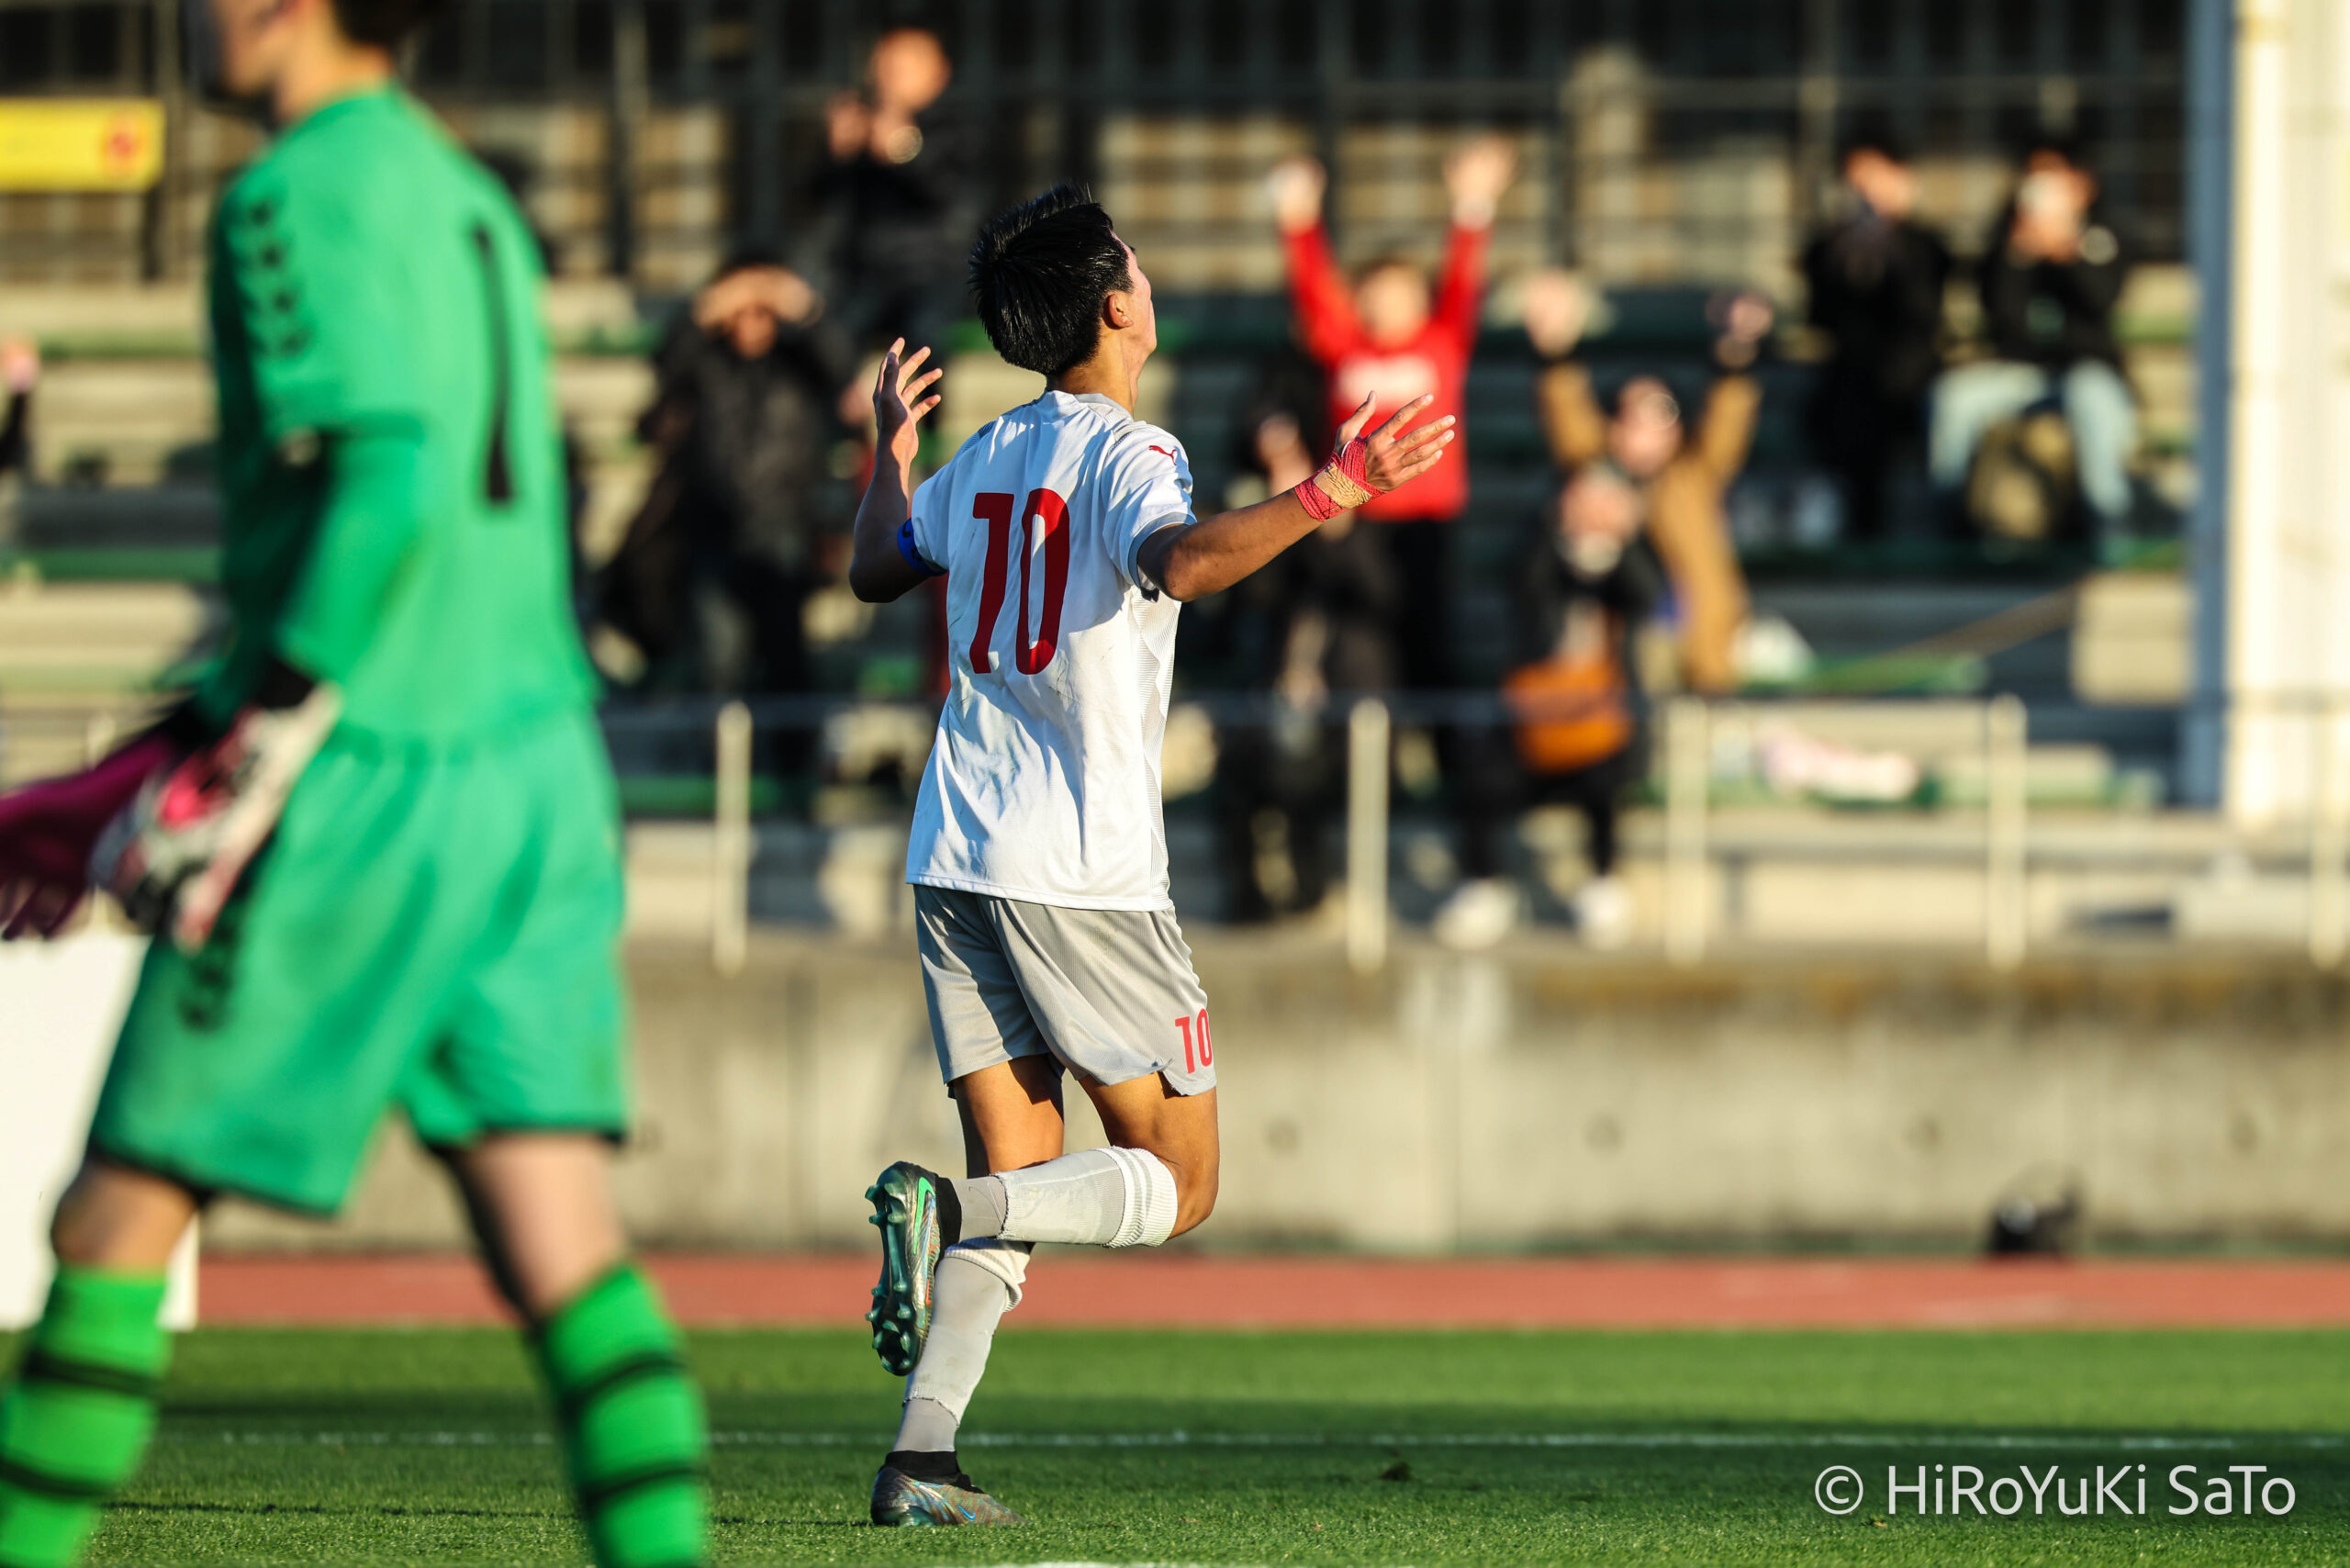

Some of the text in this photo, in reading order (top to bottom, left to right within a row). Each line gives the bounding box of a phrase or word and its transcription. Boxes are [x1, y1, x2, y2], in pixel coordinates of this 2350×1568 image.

[471, 220, 514, 503] 1
[969, 487, 1070, 676] 10
[1174, 1008, 1213, 1075] 10
